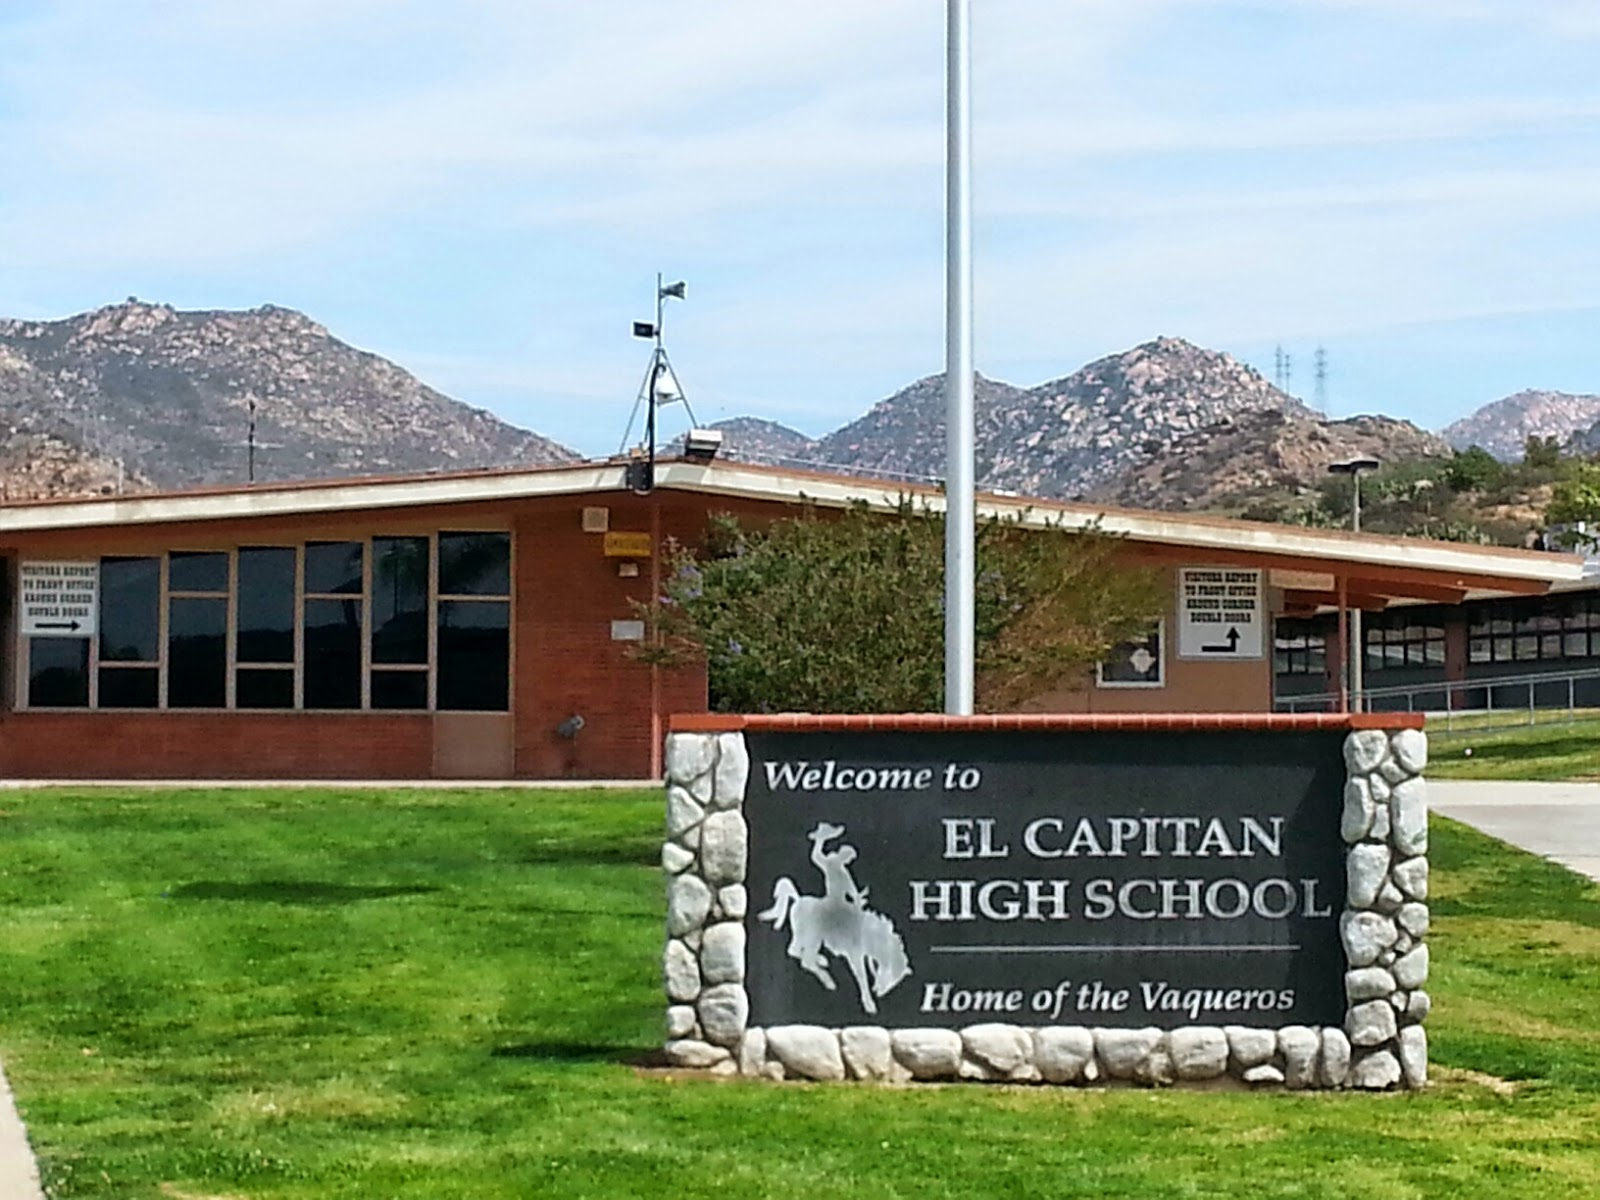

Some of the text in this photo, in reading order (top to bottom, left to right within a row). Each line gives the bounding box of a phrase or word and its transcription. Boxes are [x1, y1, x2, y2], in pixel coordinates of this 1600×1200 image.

[1184, 572, 1258, 582] VISITORS REPORT
[1185, 586, 1257, 596] TO FRONT OFFICE
[1186, 599, 1256, 610] AROUND CORNER
[1190, 612, 1252, 623] DOUBLE DOORS
[764, 760, 980, 791] Welcome to
[942, 816, 1284, 859] EL CAPITAN
[909, 877, 1332, 921] HIGH SCHOOL
[920, 980, 1295, 1020] Home of the Vaqueros
